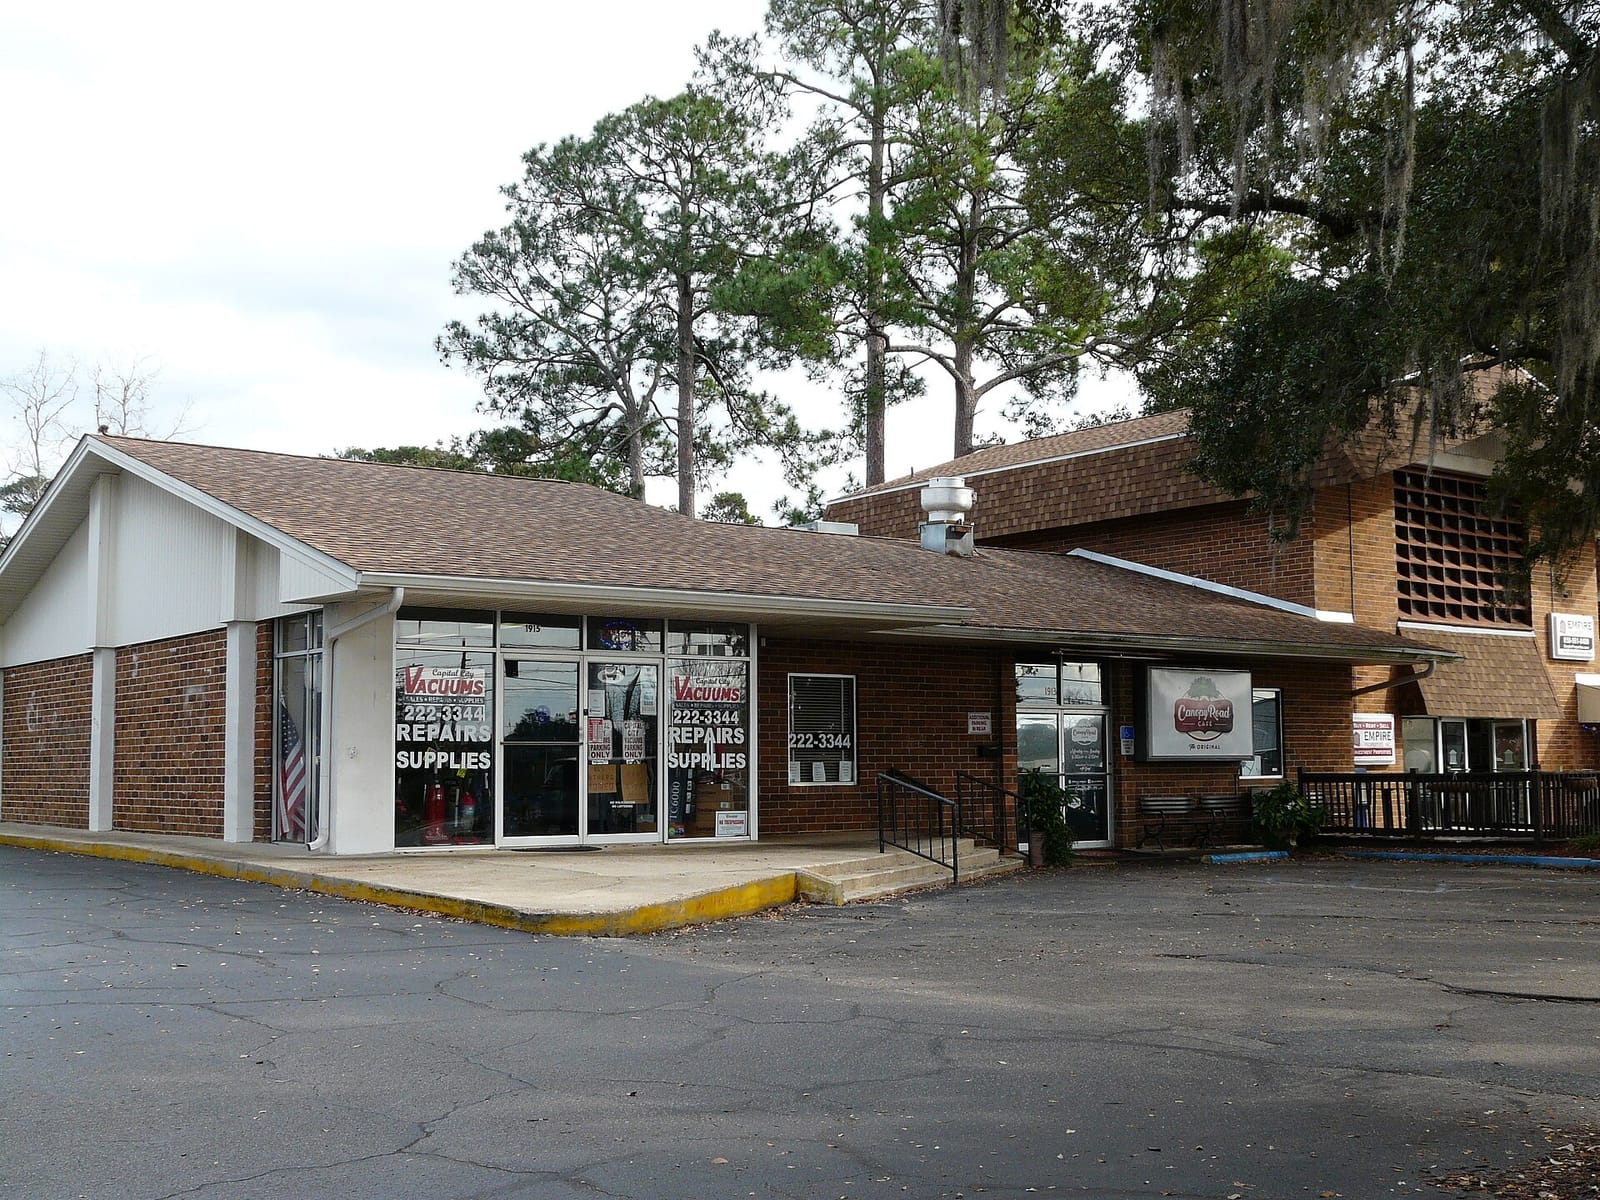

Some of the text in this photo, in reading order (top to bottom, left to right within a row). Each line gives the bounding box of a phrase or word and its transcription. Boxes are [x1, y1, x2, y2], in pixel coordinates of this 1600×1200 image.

[1567, 620, 1592, 630] EMPIRE
[405, 666, 484, 695] VACUUMS
[432, 668, 474, 679] Capital City
[674, 675, 740, 701] VACUUMS
[404, 706, 483, 721] 222-3344
[673, 710, 739, 724] 222-3344
[1178, 704, 1230, 721] Canopy Road
[396, 723, 492, 742] REPAIRS
[668, 727, 745, 744] REPAIRS
[1364, 731, 1392, 741] EMPIRE
[790, 733, 851, 749] 222-3344
[396, 751, 491, 769] SUPPLIES
[668, 753, 746, 768] SUPPLIES
